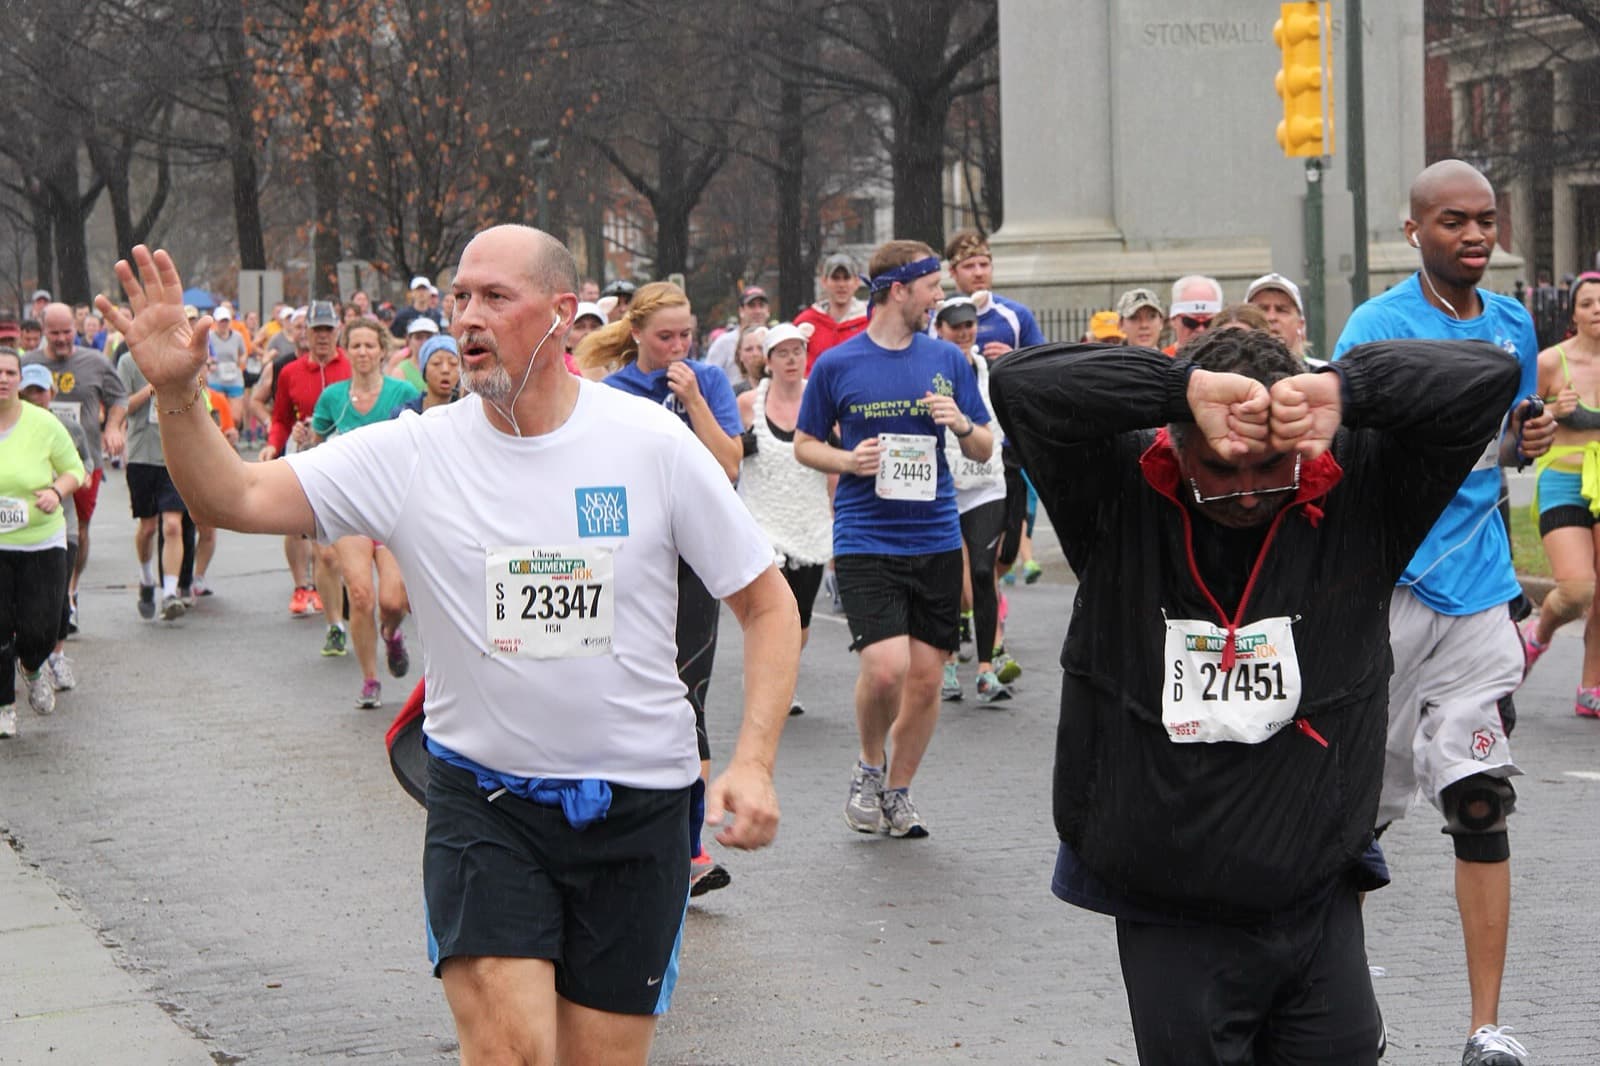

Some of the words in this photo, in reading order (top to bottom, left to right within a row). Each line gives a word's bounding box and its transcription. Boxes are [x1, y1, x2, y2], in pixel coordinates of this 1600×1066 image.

[1144, 20, 1263, 46] STONEWALL
[849, 400, 911, 413] STUDENTS
[864, 409, 905, 419] PHILLY
[893, 462, 931, 481] 24443
[585, 491, 619, 507] NEW
[580, 504, 624, 520] YORK
[588, 518, 621, 533] LIFE
[574, 569, 592, 580] 10K
[495, 582, 504, 600] S
[521, 584, 602, 620] 23347
[496, 603, 505, 620] B
[545, 624, 561, 633] FISH
[1256, 644, 1277, 658] 10K
[1174, 660, 1183, 680] S
[1200, 662, 1287, 701] 27451
[1174, 683, 1183, 702] D
[1175, 728, 1197, 736] 2014
